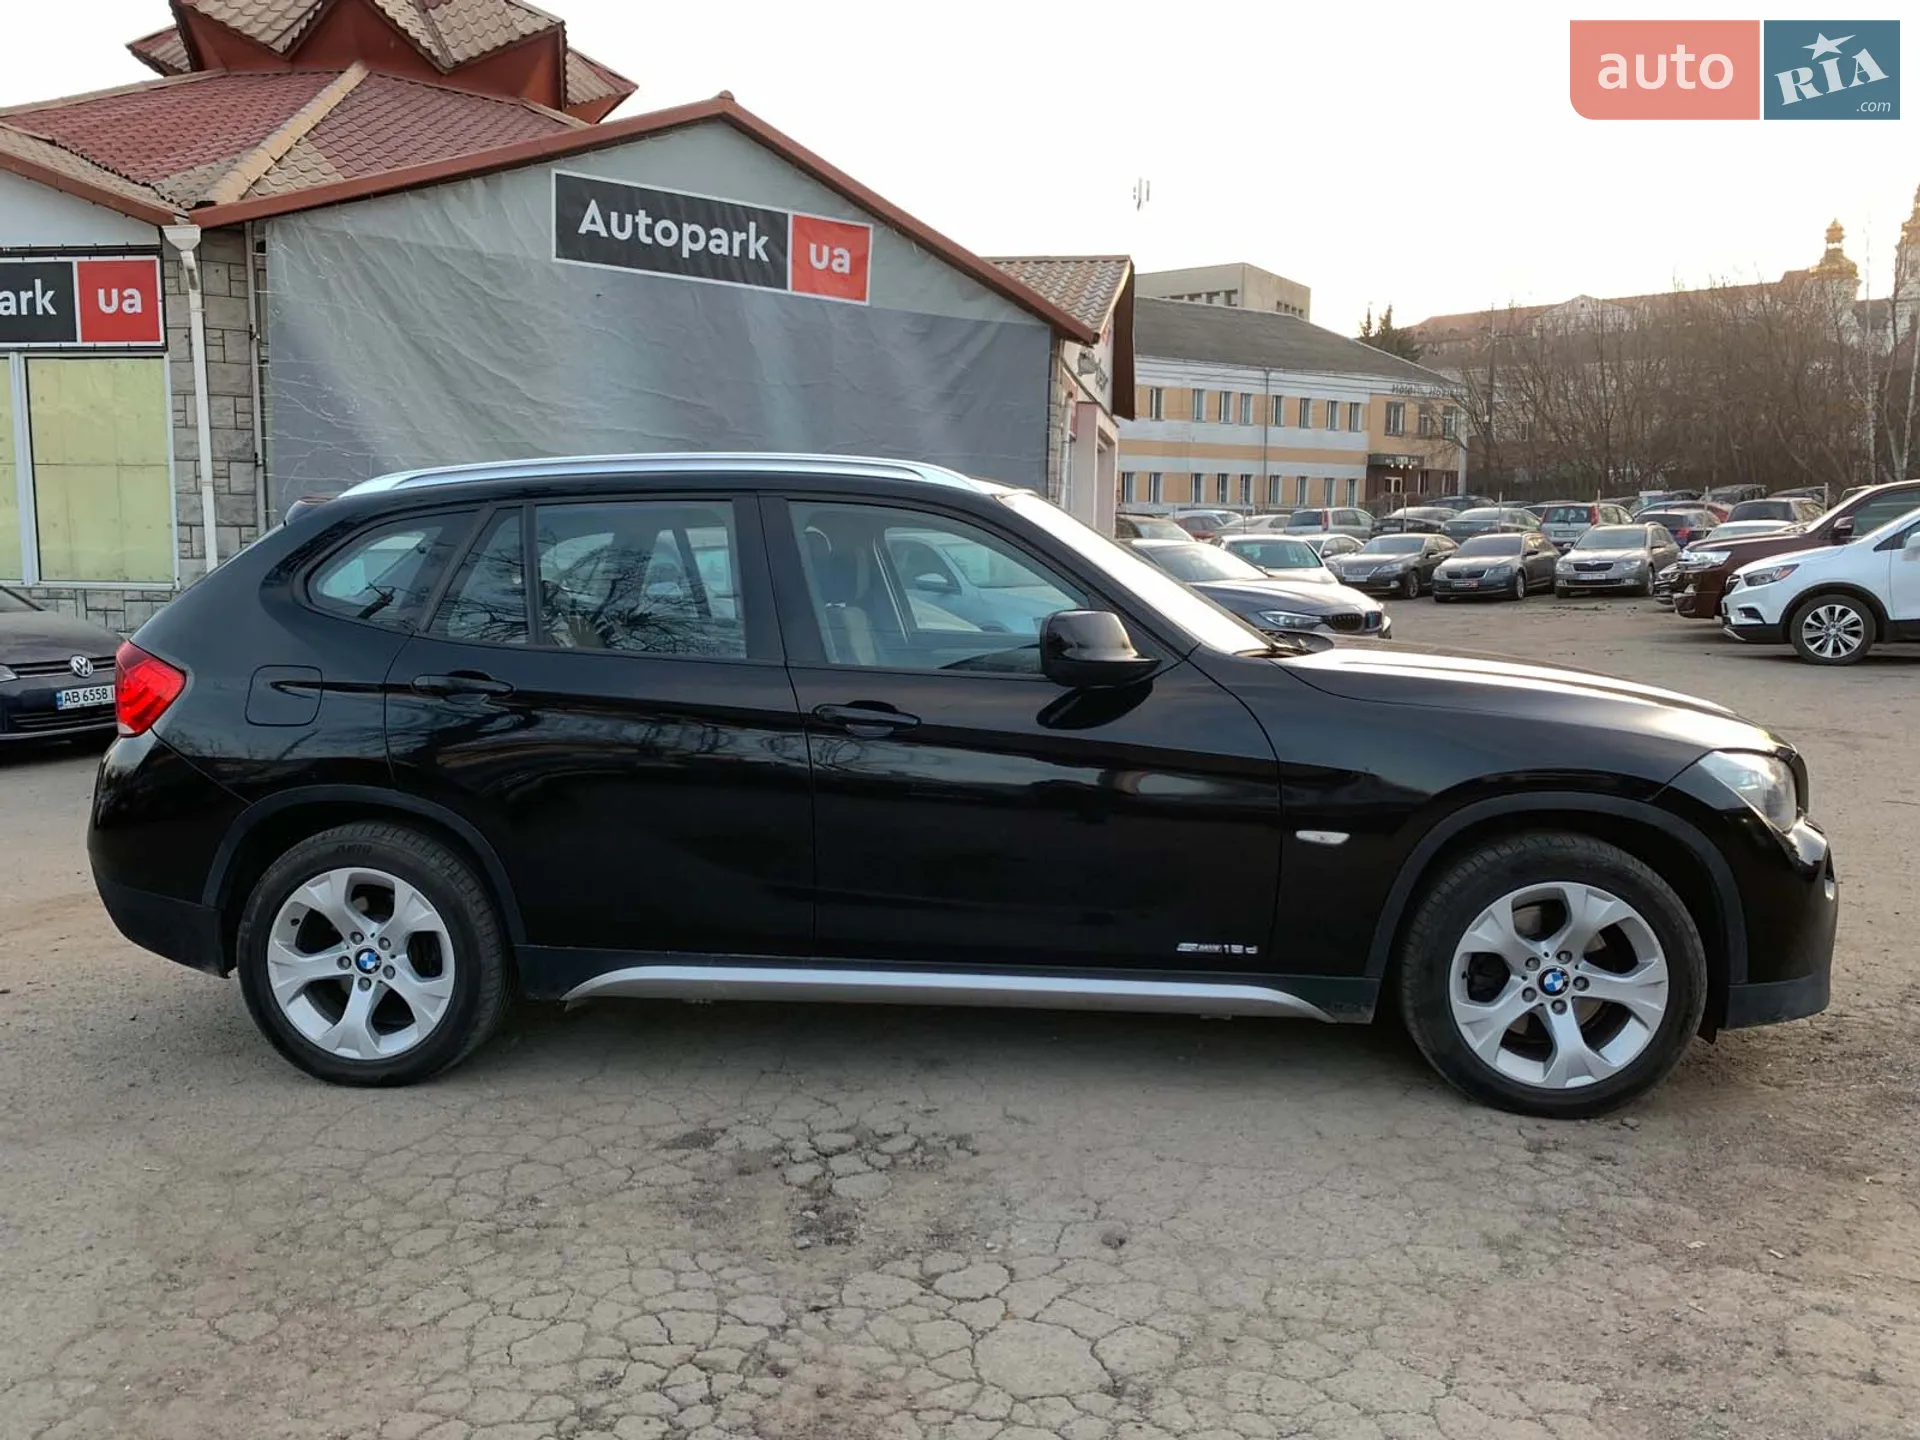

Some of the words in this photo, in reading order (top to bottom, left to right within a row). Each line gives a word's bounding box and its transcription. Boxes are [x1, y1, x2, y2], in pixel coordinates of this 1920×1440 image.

[577, 199, 769, 262] Autopark
[809, 242, 851, 274] ua
[0, 278, 57, 316] ark
[97, 287, 143, 315] ua
[64, 691, 81, 704] AB
[82, 688, 108, 702] 6558
